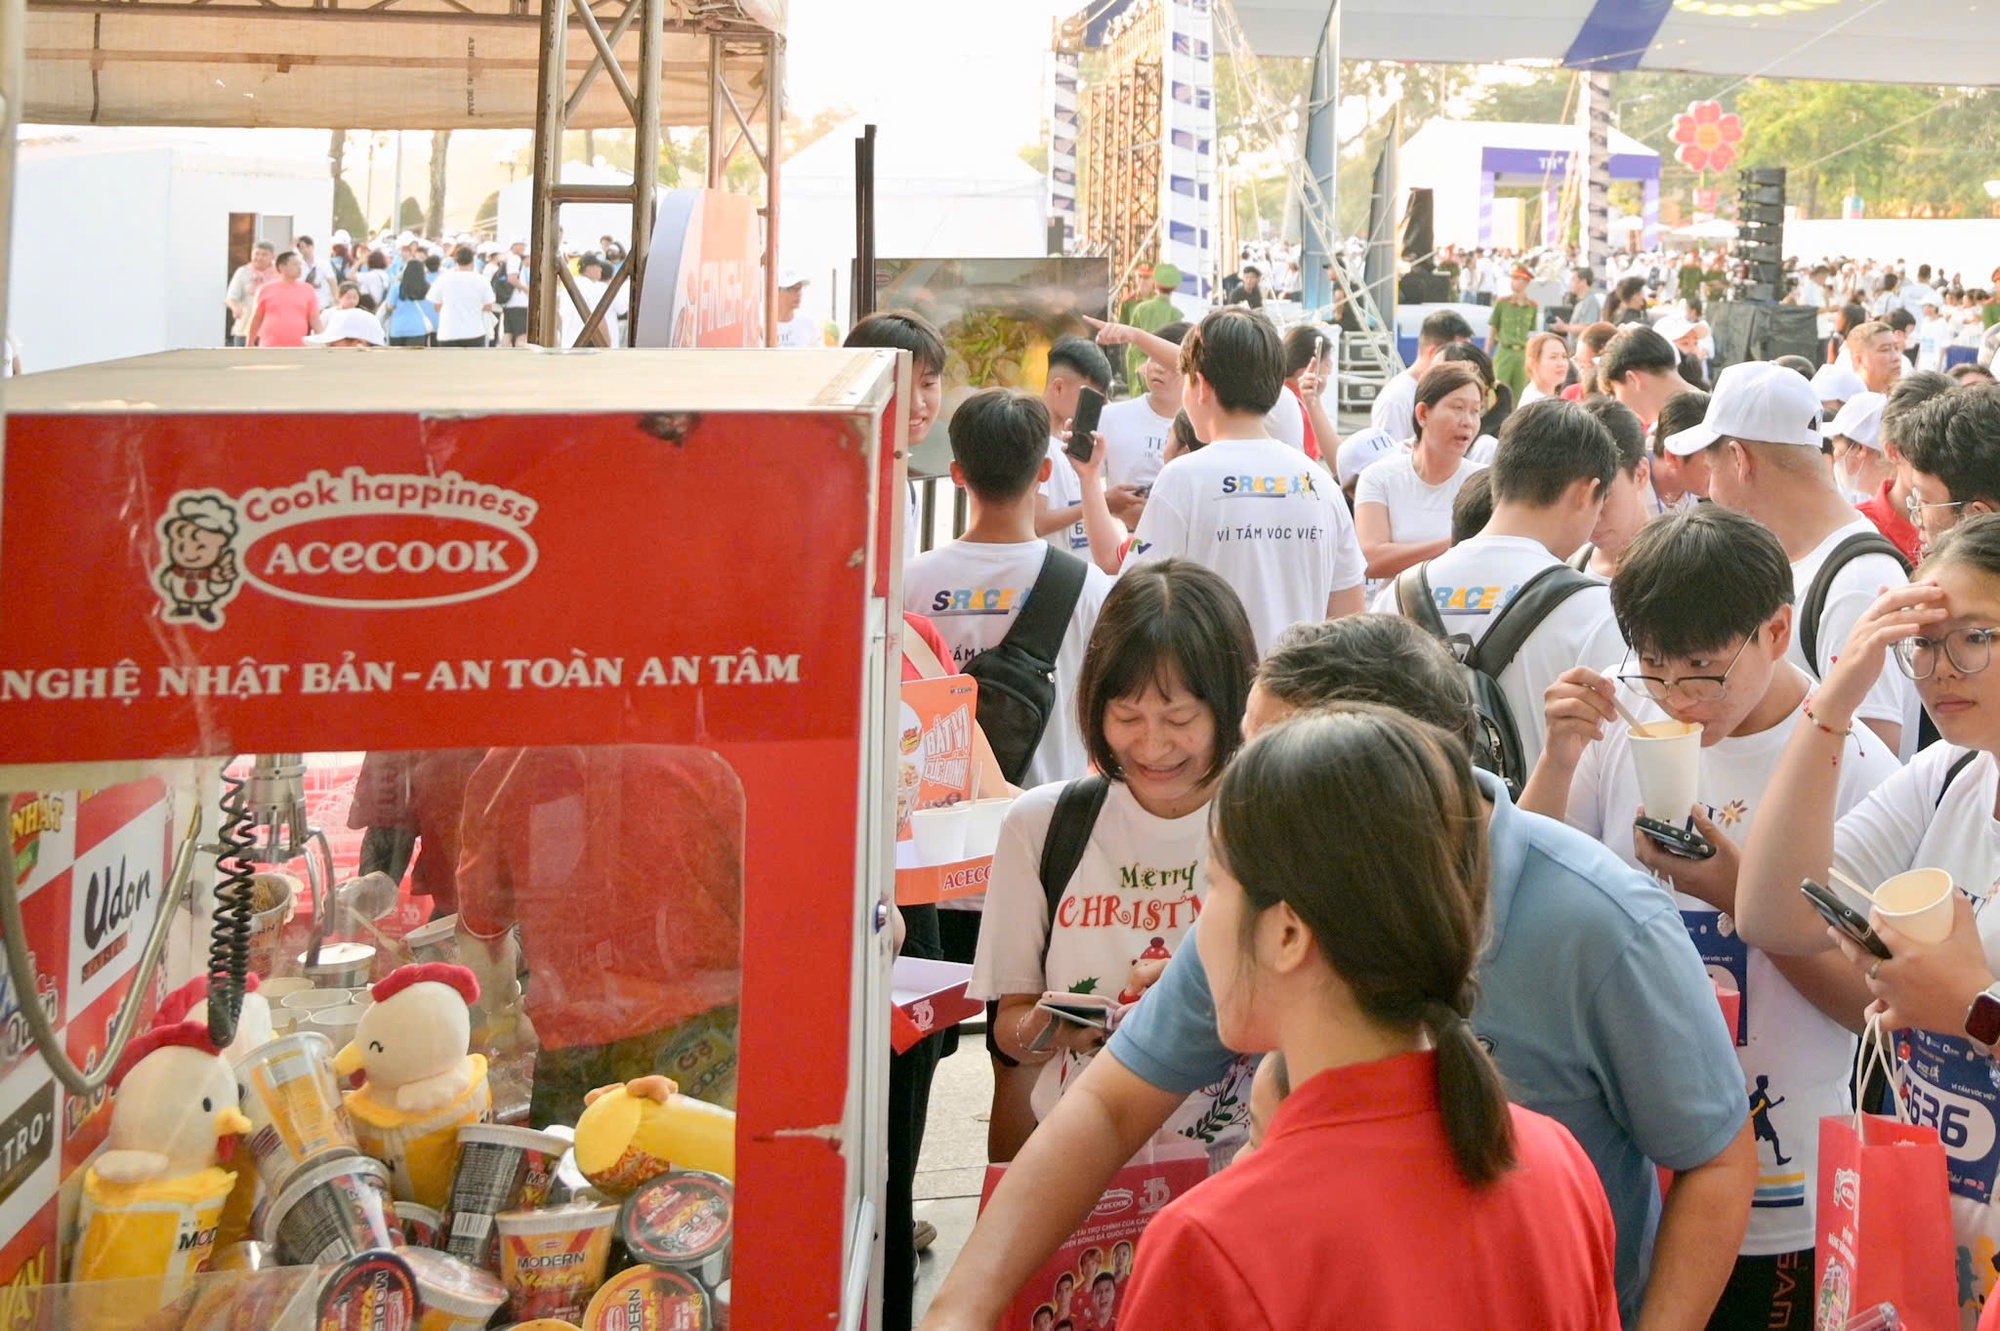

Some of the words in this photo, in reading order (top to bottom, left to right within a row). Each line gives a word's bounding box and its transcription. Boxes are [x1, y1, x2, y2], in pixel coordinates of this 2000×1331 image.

[245, 478, 339, 523] Cook
[351, 475, 532, 523] happiness
[1216, 526, 1231, 542] VÌ
[1, 657, 142, 706] NGHỆ
[157, 655, 290, 700] NHẬT
[301, 649, 396, 694] BẢN
[425, 659, 492, 692] AN
[502, 648, 625, 690] TOÀN
[636, 655, 701, 686] AN
[709, 645, 801, 685] TÂM
[1119, 859, 1199, 892] Merry
[84, 854, 151, 950] Udon
[516, 1251, 588, 1269] MODERN
